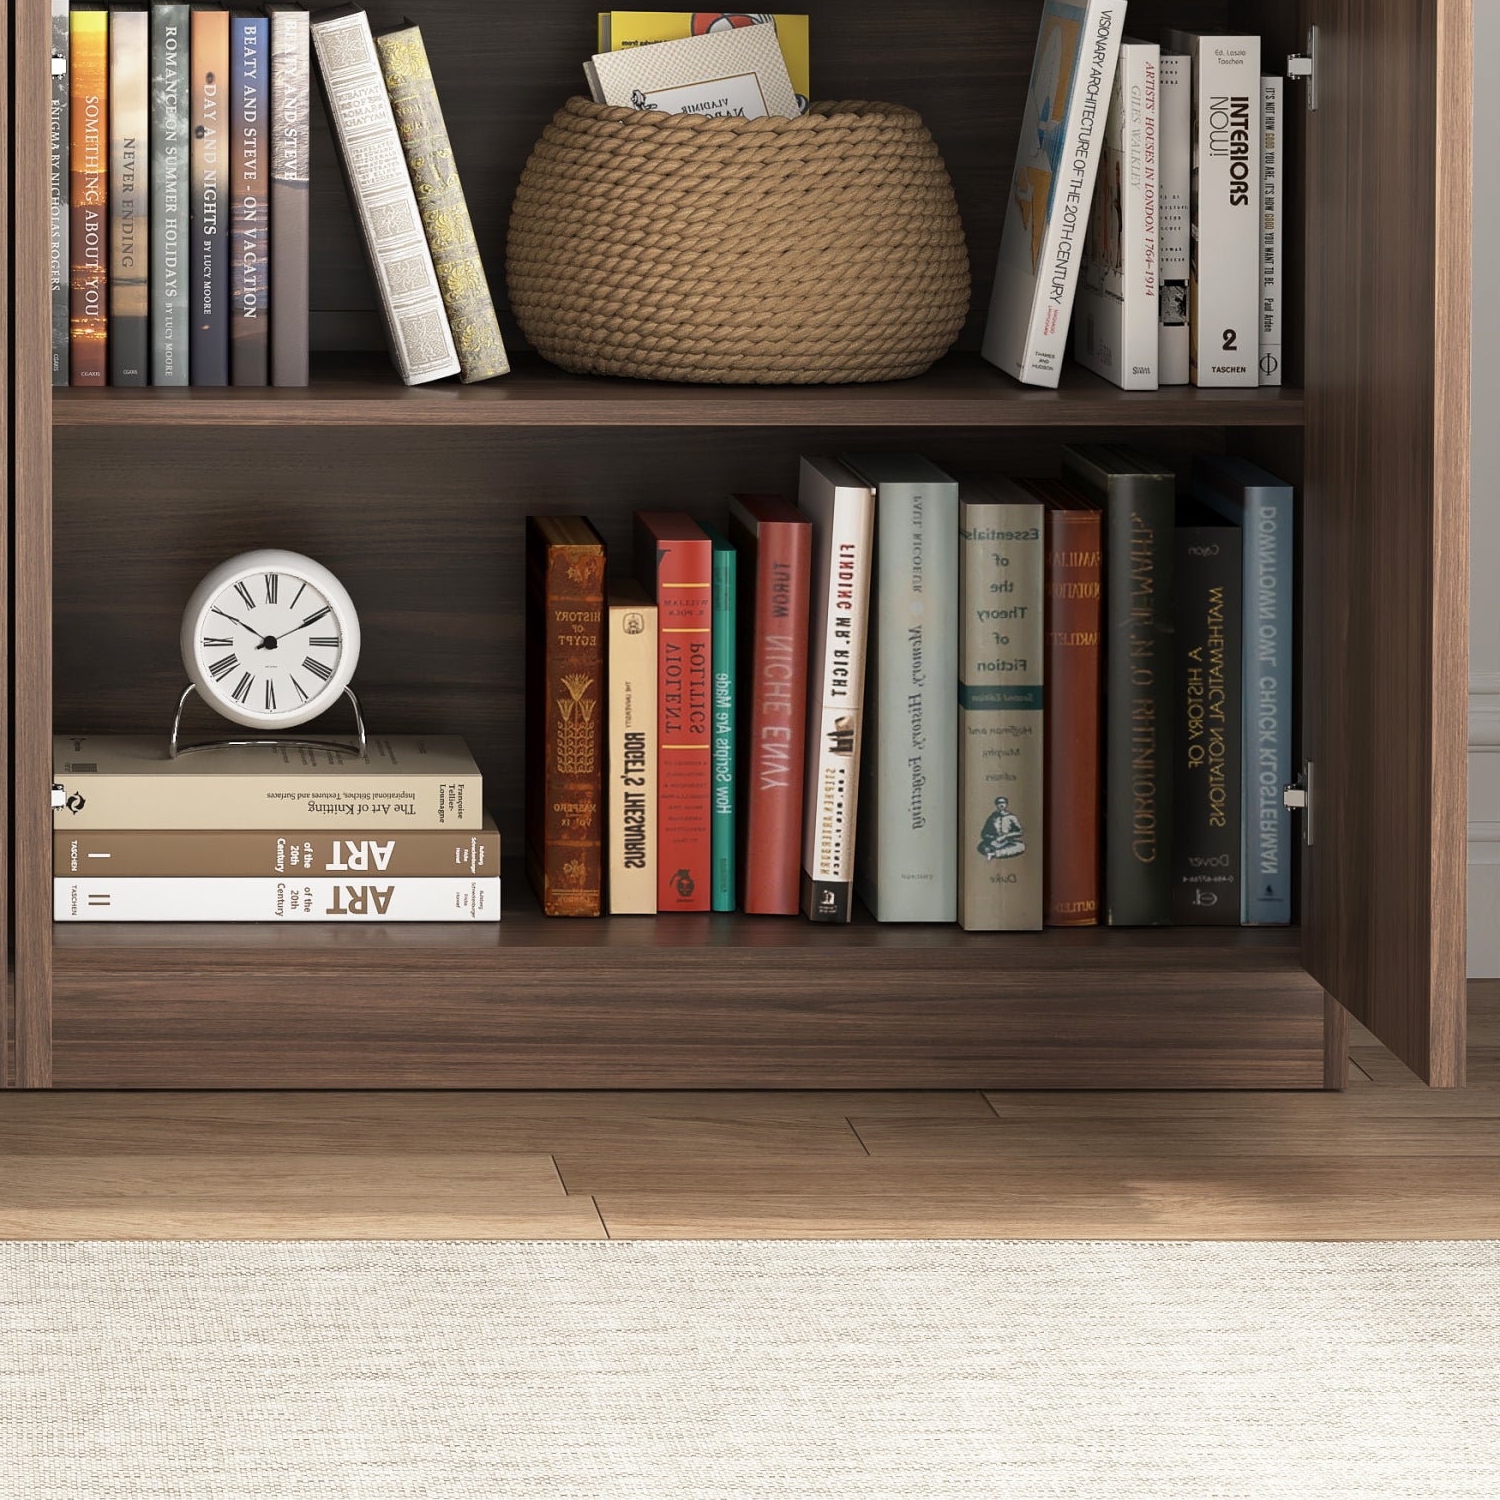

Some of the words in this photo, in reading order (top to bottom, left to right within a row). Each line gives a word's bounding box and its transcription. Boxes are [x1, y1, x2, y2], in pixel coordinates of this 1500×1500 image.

[244, 26, 258, 80] BEATY
[284, 19, 298, 77] BEATY
[1092, 9, 1112, 68] VISIONARY
[164, 26, 178, 114] ROMANCE
[204, 84, 217, 121] DAY
[244, 85, 258, 122] AND
[284, 83, 298, 122] AND
[1130, 85, 1141, 124] GILES
[1145, 62, 1156, 114] ARTISTS'
[1075, 68, 1102, 158] ARCHITECTURE
[1264, 102, 1275, 114] NOT
[1264, 116, 1275, 130] HOW
[164, 118, 178, 142] ON
[1145, 117, 1155, 164] HOUSES
[1210, 96, 1228, 156] NOW!
[1264, 132, 1275, 149] GOOD
[85, 95, 99, 202] SOMETHING
[204, 128, 217, 164] AND
[244, 128, 258, 180] STEVE
[284, 128, 298, 181] STEVE
[1130, 130, 1141, 190] WALKLEY
[1230, 96, 1249, 206] INTERIORS
[1264, 152, 1275, 164] YOU
[122, 138, 136, 194] NEVER
[164, 146, 178, 214] SUMMER
[1072, 160, 1087, 176] OF
[1145, 166, 1155, 179] IN
[204, 169, 217, 235] NIGHTS
[1067, 177, 1084, 204] THE
[1145, 181, 1155, 233] LONDON
[1264, 197, 1274, 211] HOW
[244, 196, 258, 222] ON
[1060, 204, 1078, 240] 20TH
[1264, 213, 1274, 230] GOOD
[85, 210, 99, 270] ABOUT
[122, 200, 135, 268] ENDING
[203, 240, 212, 252] BY
[1264, 232, 1274, 245] YOU
[164, 218, 178, 298] HOLIDAYS
[203, 254, 212, 279] LUCY
[1050, 241, 1072, 304] CENTURY
[1264, 247, 1274, 265] WANT
[244, 228, 258, 319] VACATION
[85, 278, 99, 316] YOU
[164, 302, 174, 316] BY
[203, 281, 212, 315] MOORE
[1264, 298, 1274, 312] Paul
[164, 316, 174, 342] LUCY
[1222, 328, 1238, 350] 2
[1264, 314, 1274, 332] Arden
[164, 342, 174, 377] MOORE
[266, 792, 296, 800] Surfaces
[308, 801, 354, 815] Knitting
[312, 792, 342, 800] Textures
[357, 804, 370, 816] of
[372, 790, 416, 800] Inspirational
[372, 804, 391, 815] Art
[394, 804, 416, 815] The
[70, 840, 78, 872] TASCHEN
[274, 838, 286, 873] Century
[290, 846, 300, 866] 20th
[325, 840, 396, 871] ART
[274, 882, 286, 917] Century
[290, 890, 300, 910] 20th
[326, 886, 396, 914] ART
